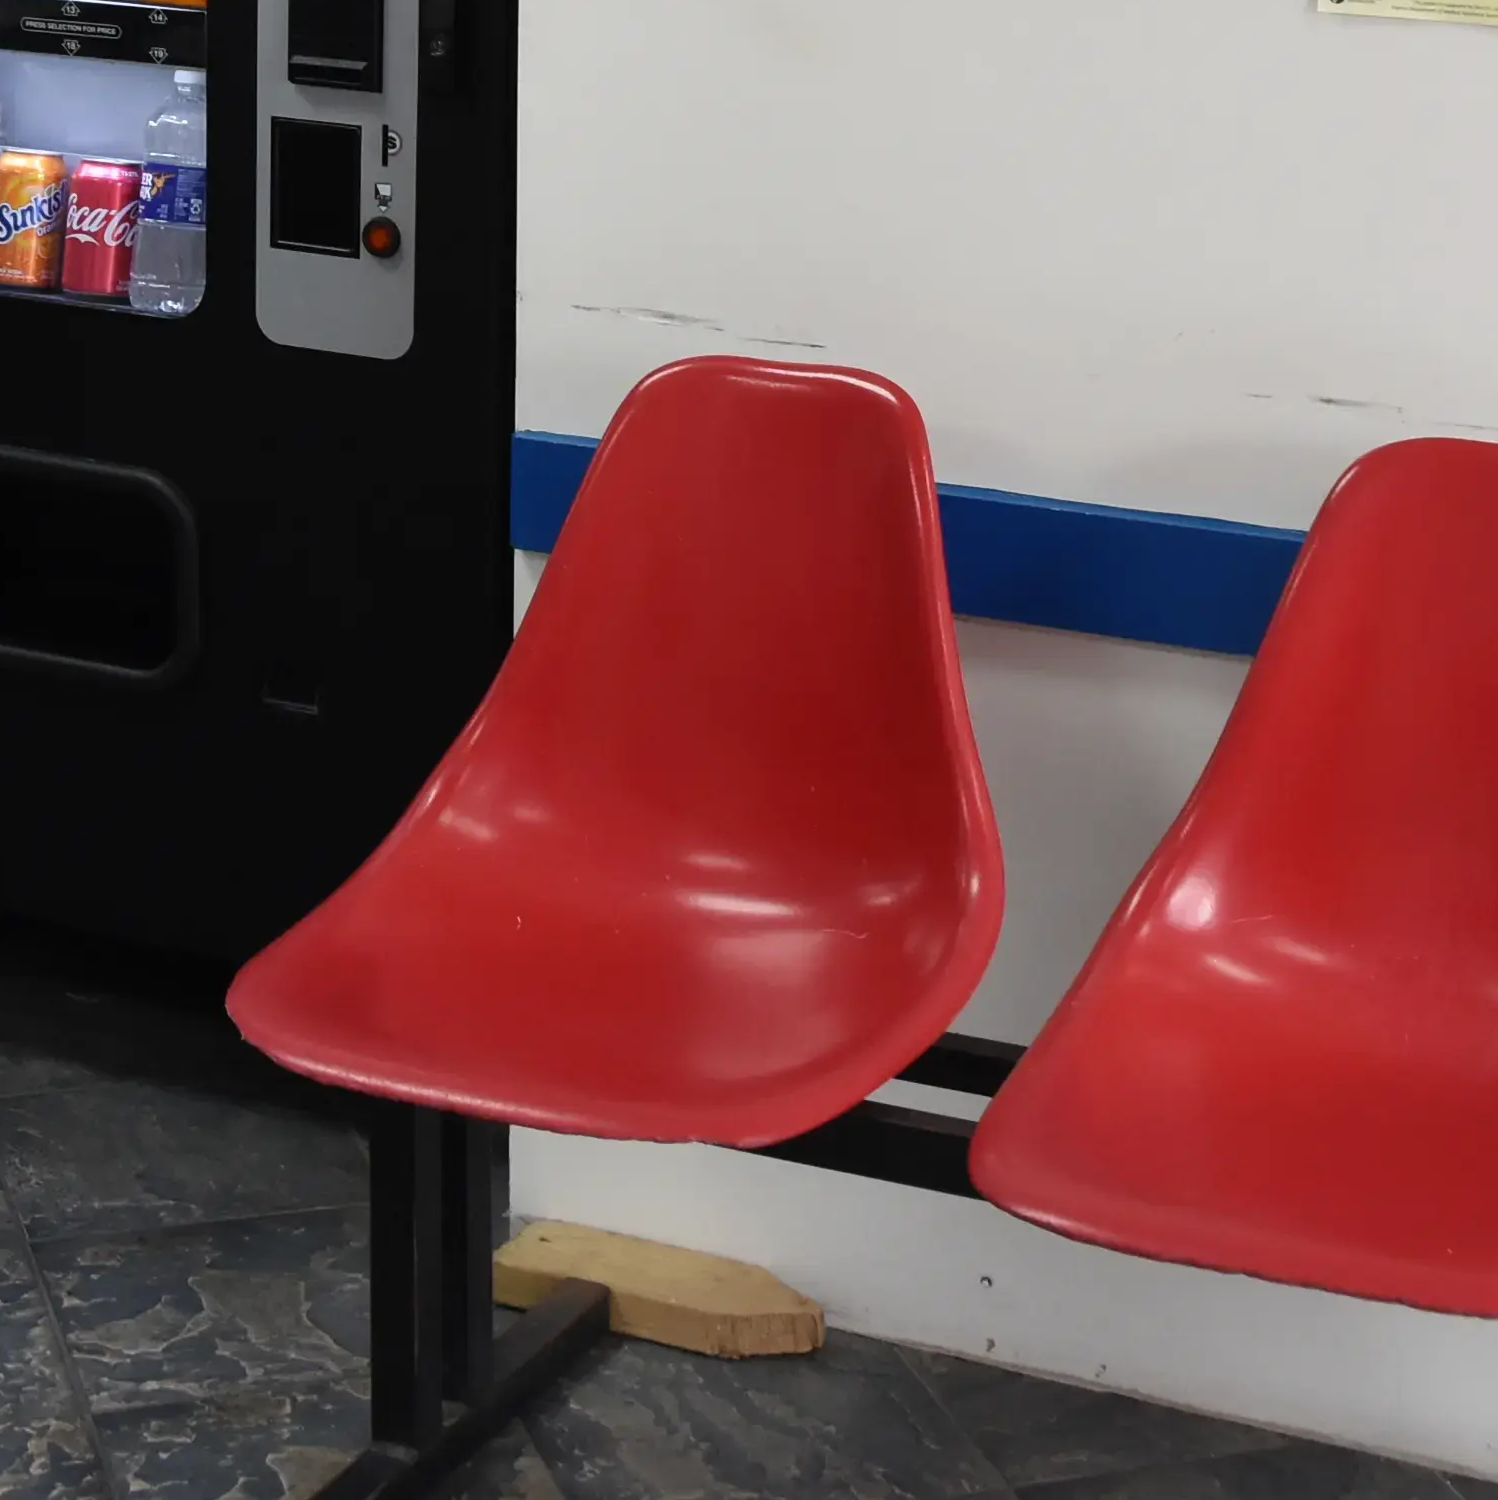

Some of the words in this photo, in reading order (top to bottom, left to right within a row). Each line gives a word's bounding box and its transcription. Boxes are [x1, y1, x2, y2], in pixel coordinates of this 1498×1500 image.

[25, 20, 47, 30] PRESS
[47, 22, 82, 32] SELECTION
[82, 25, 96, 34] FOR
[96, 26, 117, 35] PRICE
